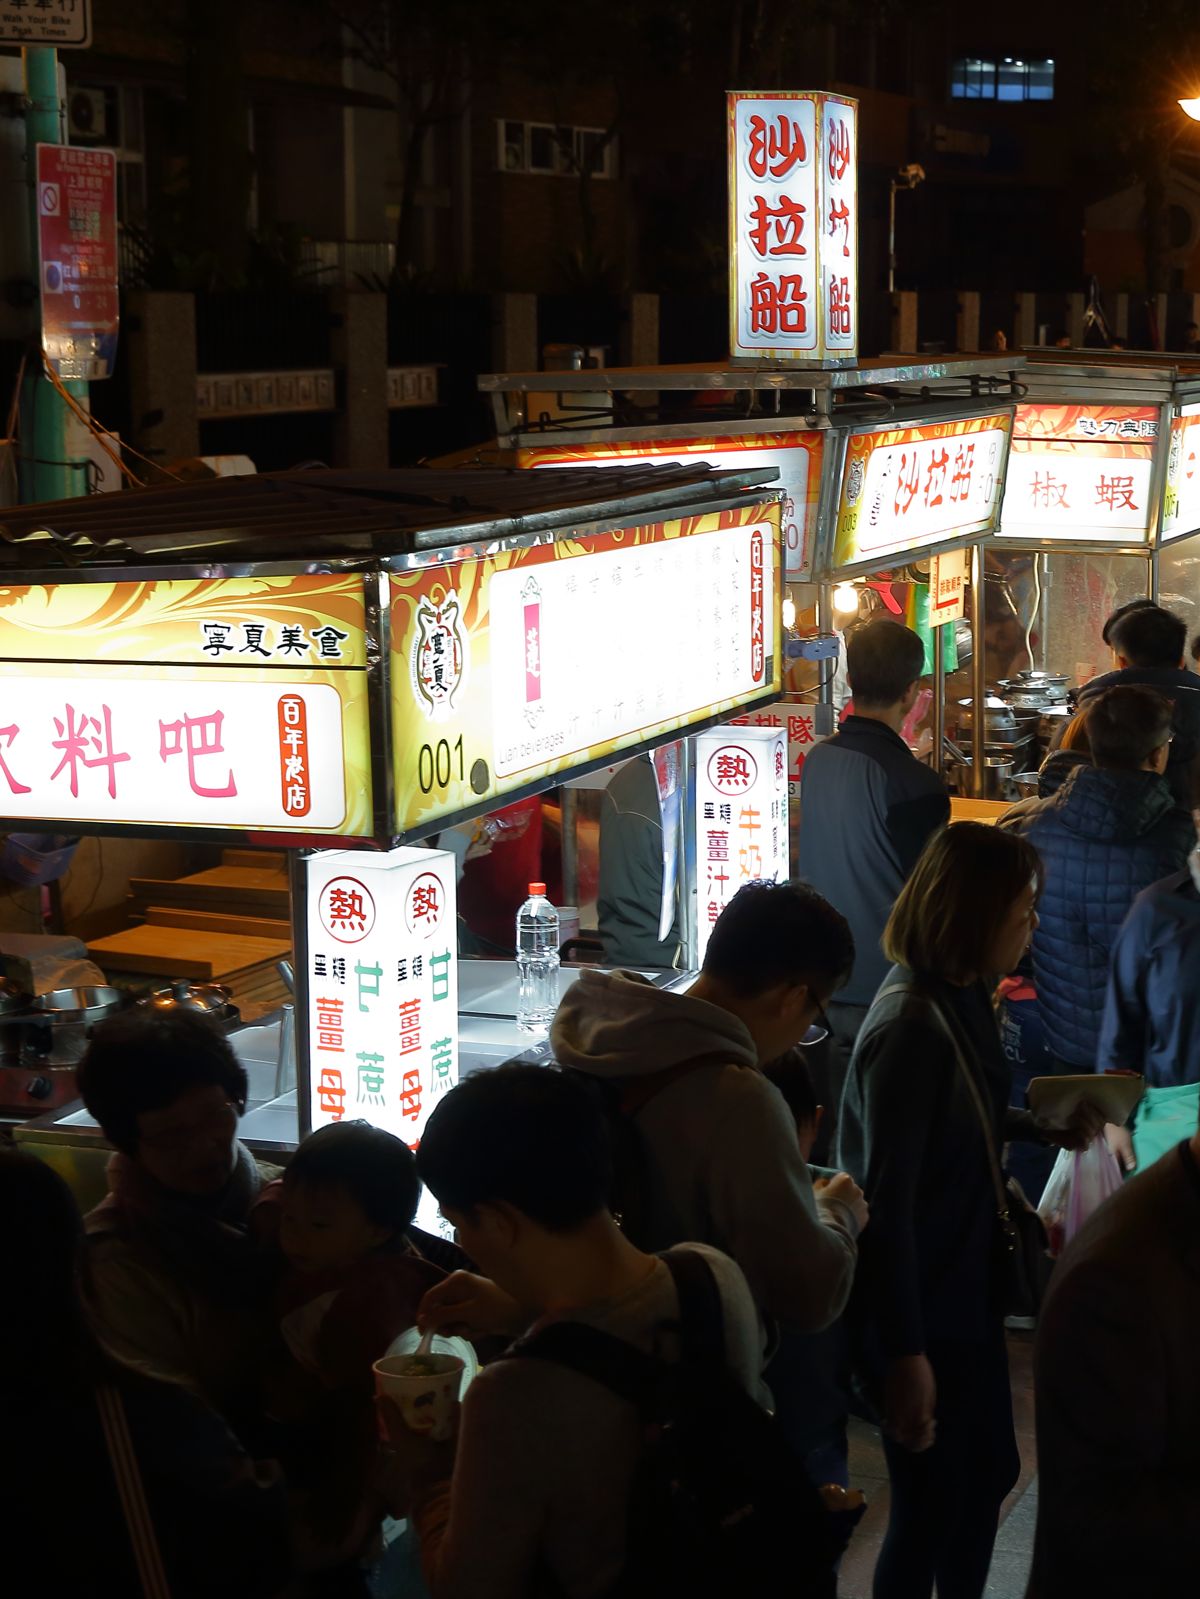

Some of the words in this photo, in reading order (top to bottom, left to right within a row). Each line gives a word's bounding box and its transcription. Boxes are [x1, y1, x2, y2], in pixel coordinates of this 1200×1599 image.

[749, 114, 807, 333] 沙拉船
[1078, 419, 1160, 438] 魅力無限
[895, 443, 975, 516] 沙拉船
[203, 623, 348, 657] 寧夏美食
[281, 699, 306, 811] 百年老店
[418, 734, 465, 794] 001
[717, 755, 750, 786] 熱
[738, 804, 761, 881] 牛奶
[330, 888, 366, 931] 熱
[412, 884, 439, 925] 熱
[354, 959, 385, 1106] 甘蔗
[430, 947, 453, 1093] 甘蔗
[316, 996, 347, 1121] 薑母
[399, 998, 422, 1151] 薑母
